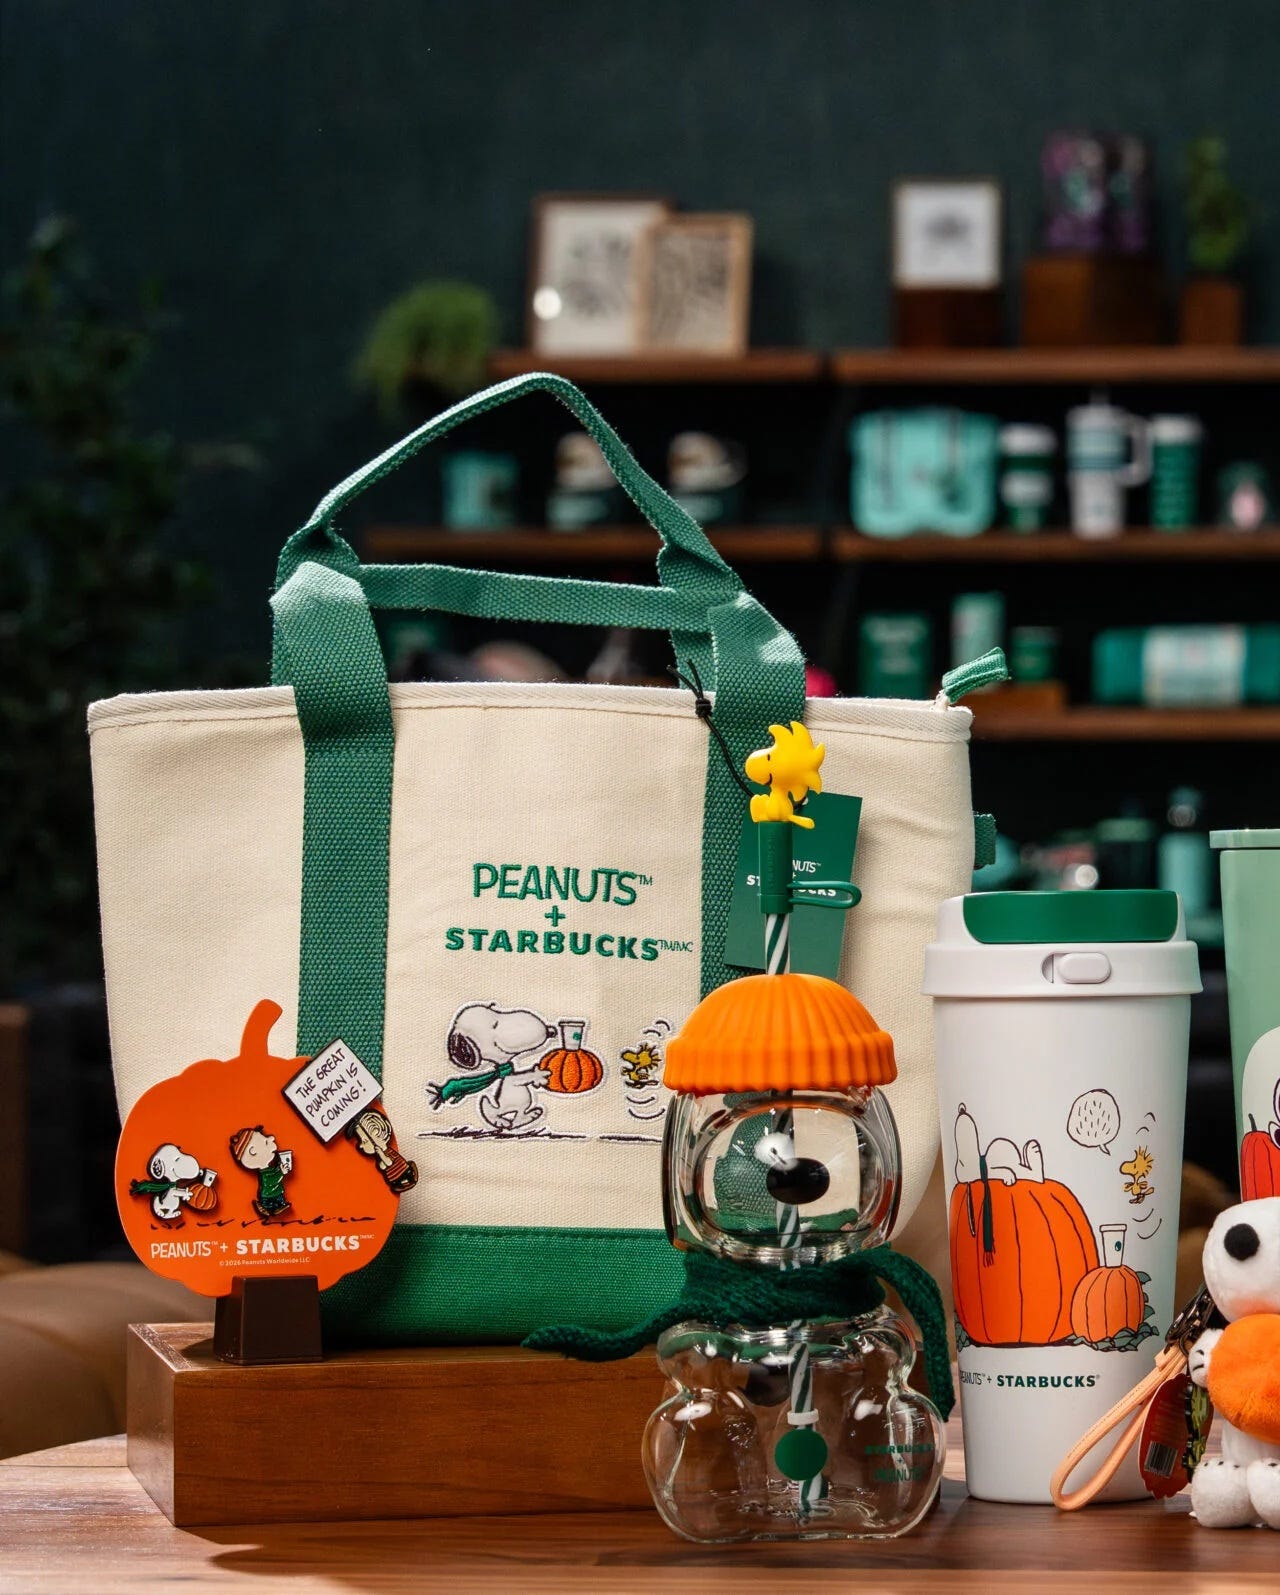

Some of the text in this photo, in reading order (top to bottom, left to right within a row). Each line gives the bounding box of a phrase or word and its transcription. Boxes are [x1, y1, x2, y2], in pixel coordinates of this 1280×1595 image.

[544, 905, 566, 927] +
[295, 1048, 346, 1098] THE GREAT
[305, 1062, 358, 1118] PUMPKIN IS
[320, 1080, 366, 1127] COMING!
